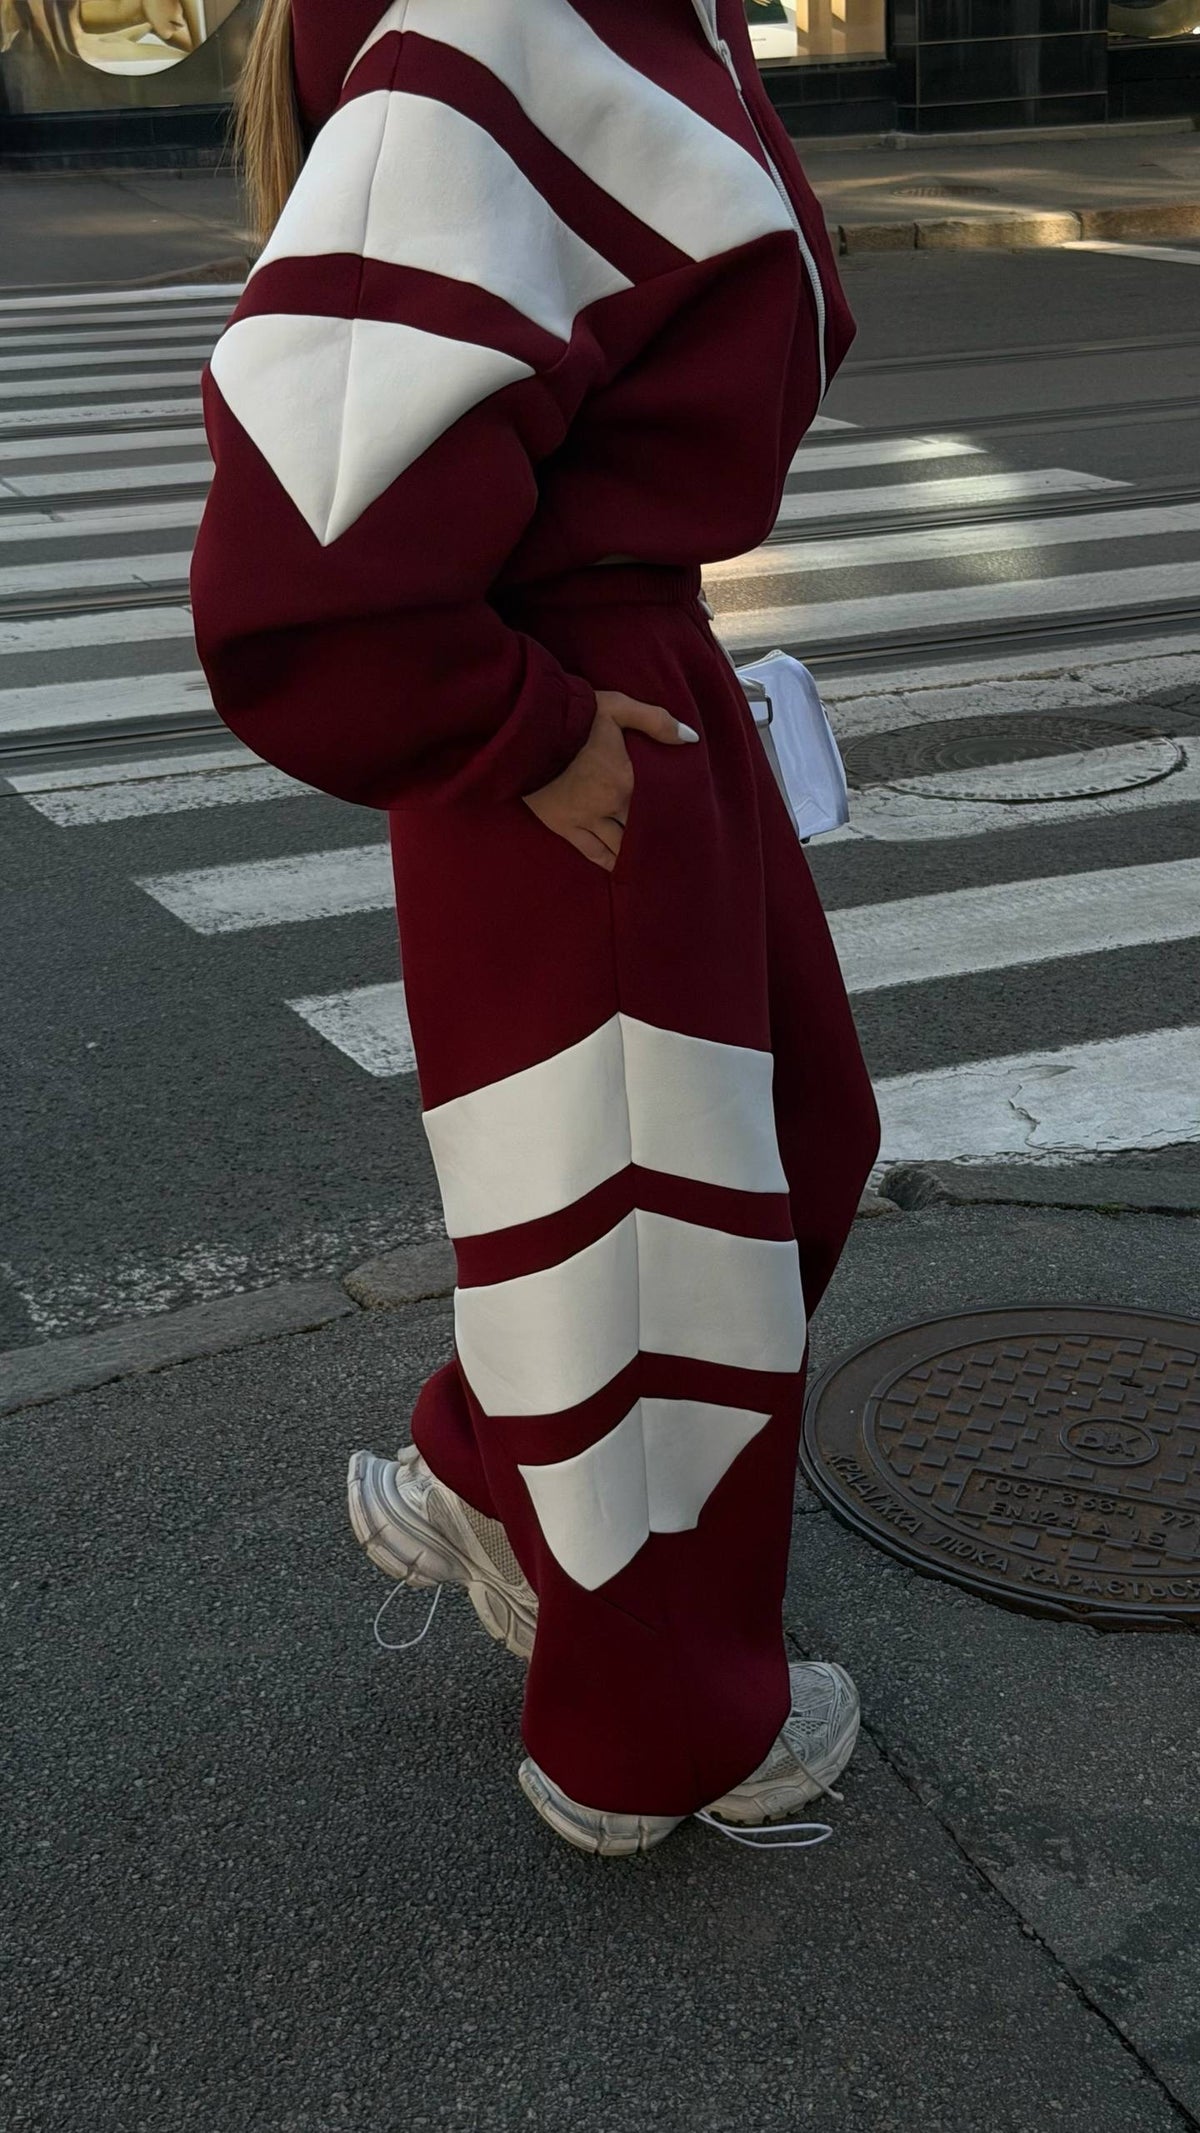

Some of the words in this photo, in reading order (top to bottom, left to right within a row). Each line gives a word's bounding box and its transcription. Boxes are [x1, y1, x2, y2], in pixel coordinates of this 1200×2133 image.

[828, 1455, 924, 1536] КРАДІЖКА
[930, 1535, 1010, 1574] ЛЮКА
[977, 1476, 1048, 1501] ГОСТ
